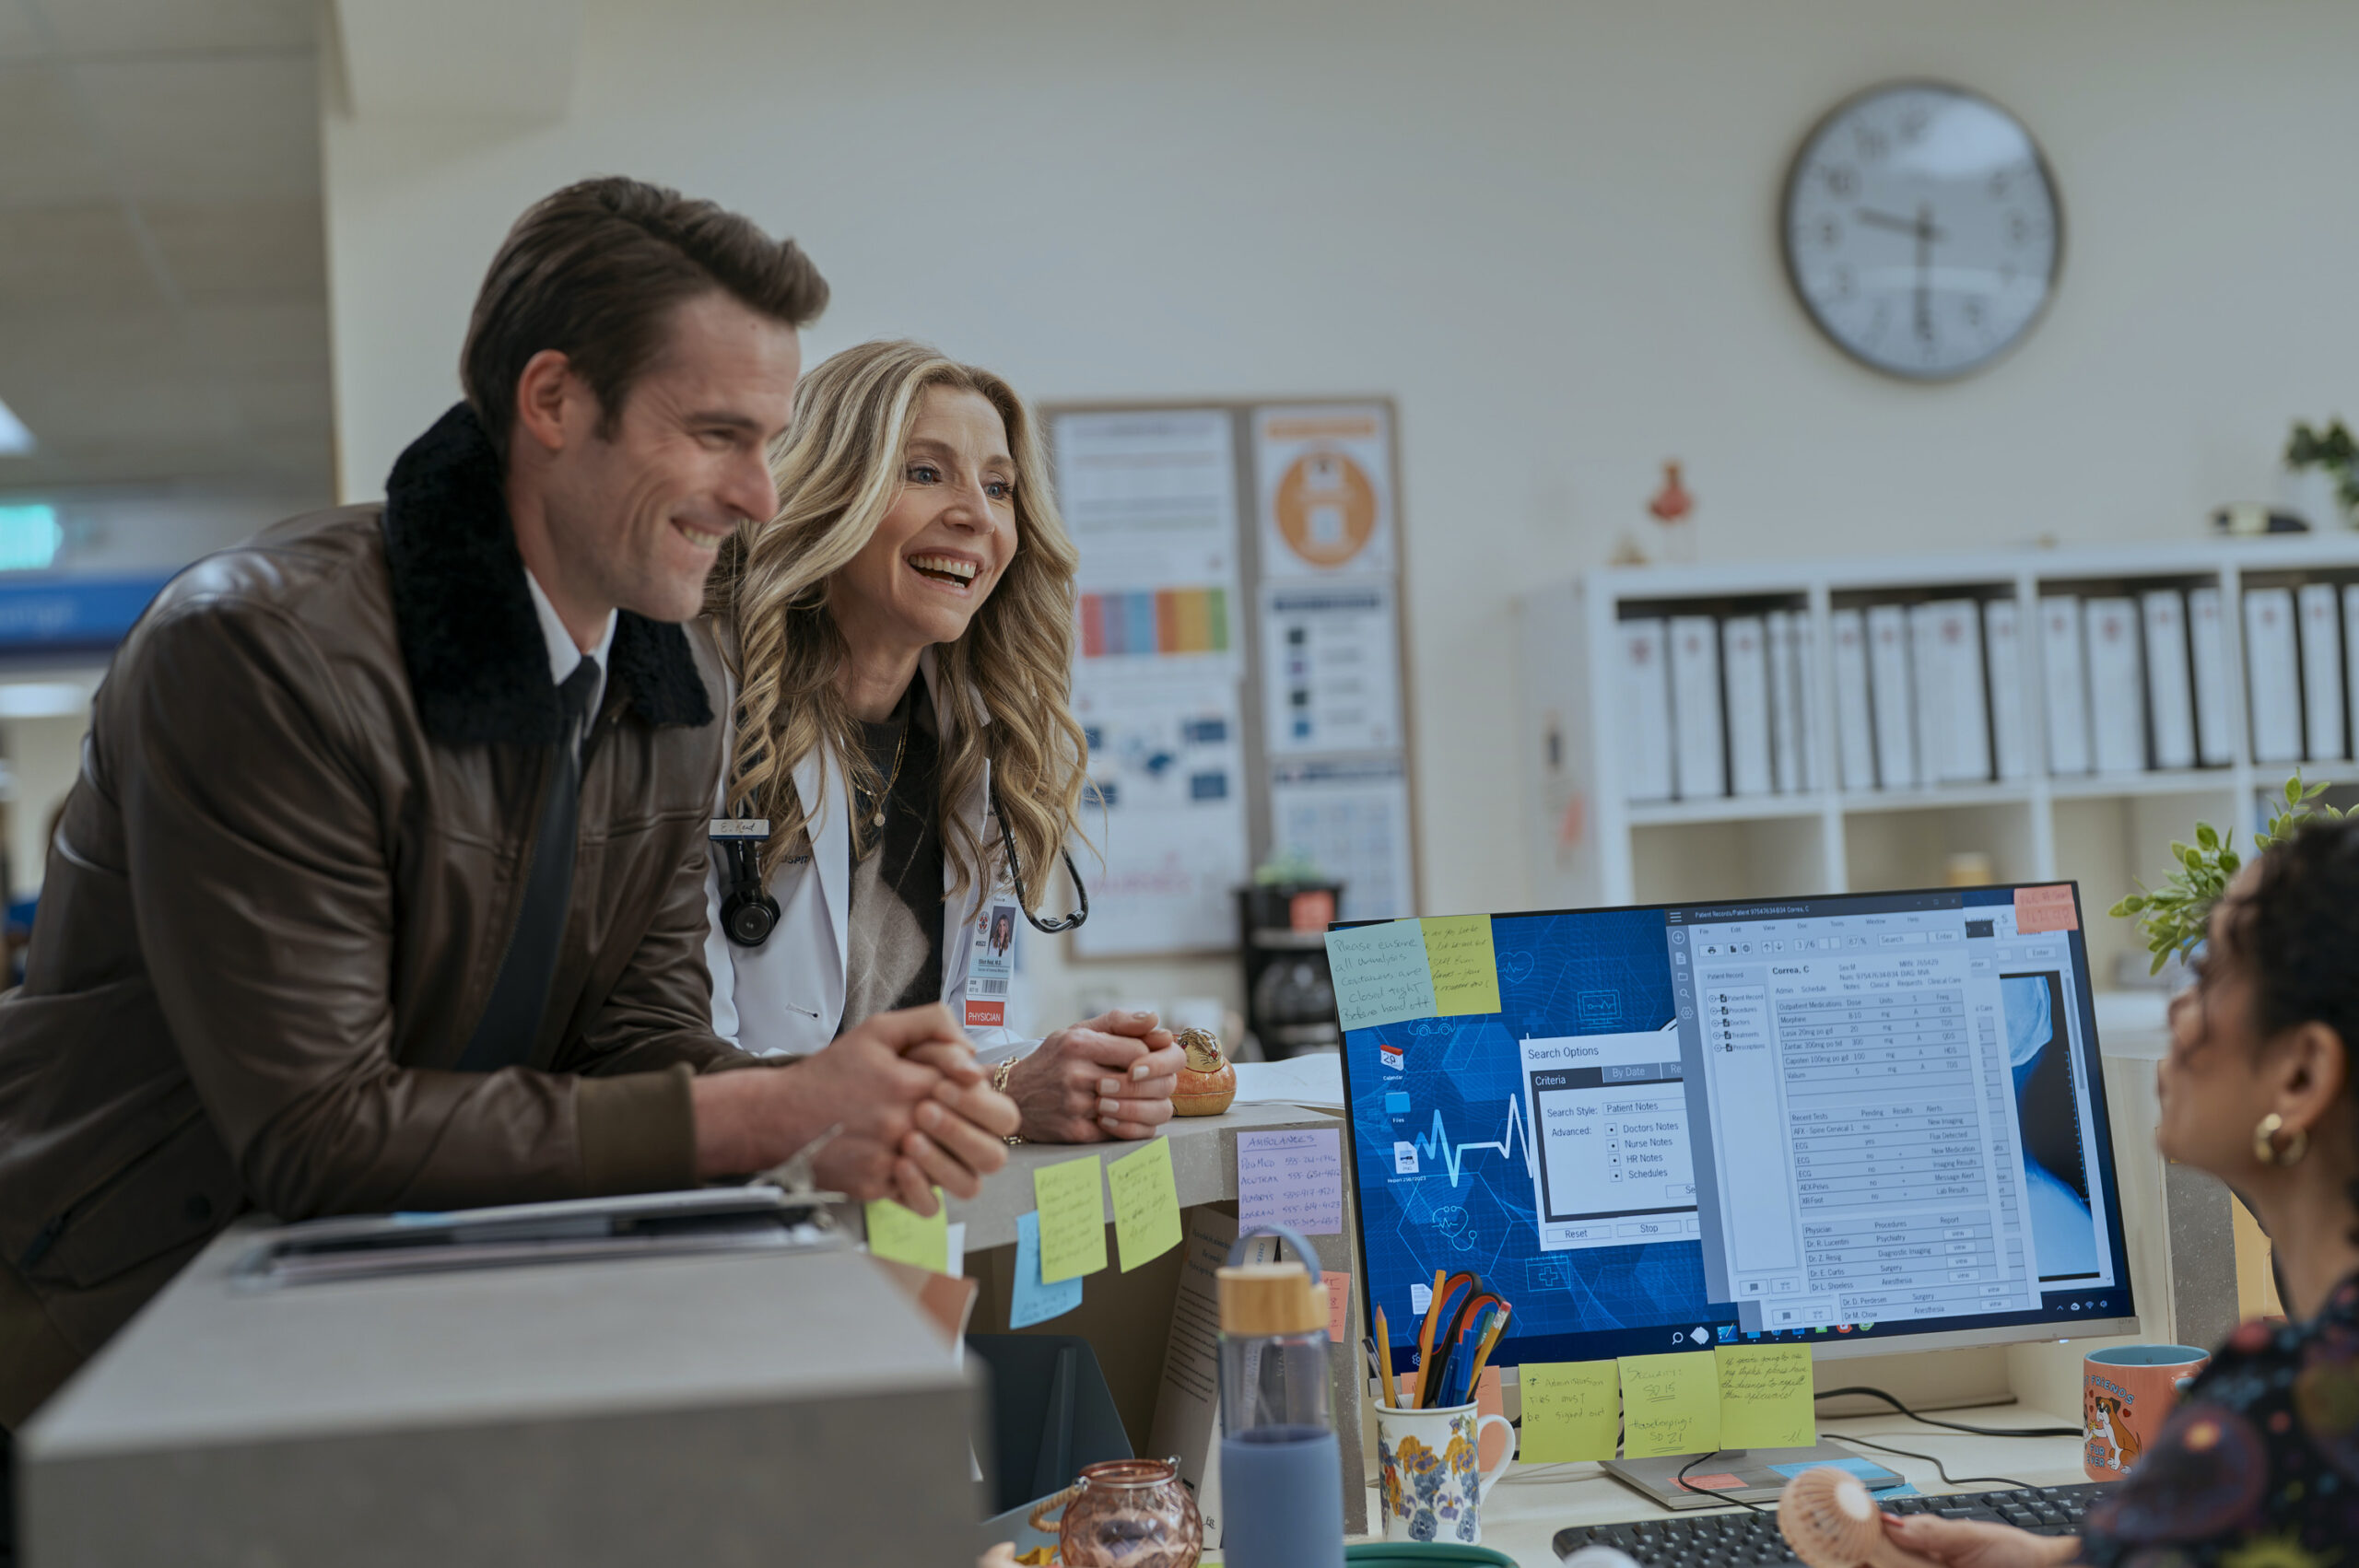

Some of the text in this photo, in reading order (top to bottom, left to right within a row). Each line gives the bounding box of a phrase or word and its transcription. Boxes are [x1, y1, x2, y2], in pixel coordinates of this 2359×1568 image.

[1881, 932, 1954, 944] Search Enter
[1333, 939, 1371, 953] Please
[1772, 965, 1802, 977] Correa,
[968, 1012, 1001, 1023] PHYSICIAN
[1528, 1045, 1600, 1060] Search Options
[1534, 1074, 1567, 1087] Criteria
[1612, 1066, 1626, 1080] By
[1628, 1065, 1646, 1077] Date
[1546, 1101, 1660, 1119] Search Style: Patient Notes
[1791, 1113, 1812, 1122] Recent
[1551, 1125, 1592, 1138] Advanced:
[1623, 1120, 1679, 1134] Doctors Notes
[1625, 1136, 1673, 1150] Nurse Notes
[1795, 1141, 1809, 1151] ECG
[1625, 1152, 1664, 1164] HR Notes
[1797, 1156, 1811, 1164] ECG
[1627, 1168, 1669, 1180] Schedules
[1798, 1169, 1812, 1178] ECG
[1805, 1215, 1959, 1235] Physician Procedures Report
[1564, 1223, 1660, 1240] Reset Stop
[1876, 1235, 1906, 1244] Psychiatry
[1880, 1264, 1903, 1273] Surgery
[1912, 1293, 1935, 1302] Surgery
[2089, 1443, 2106, 1457] FUR
